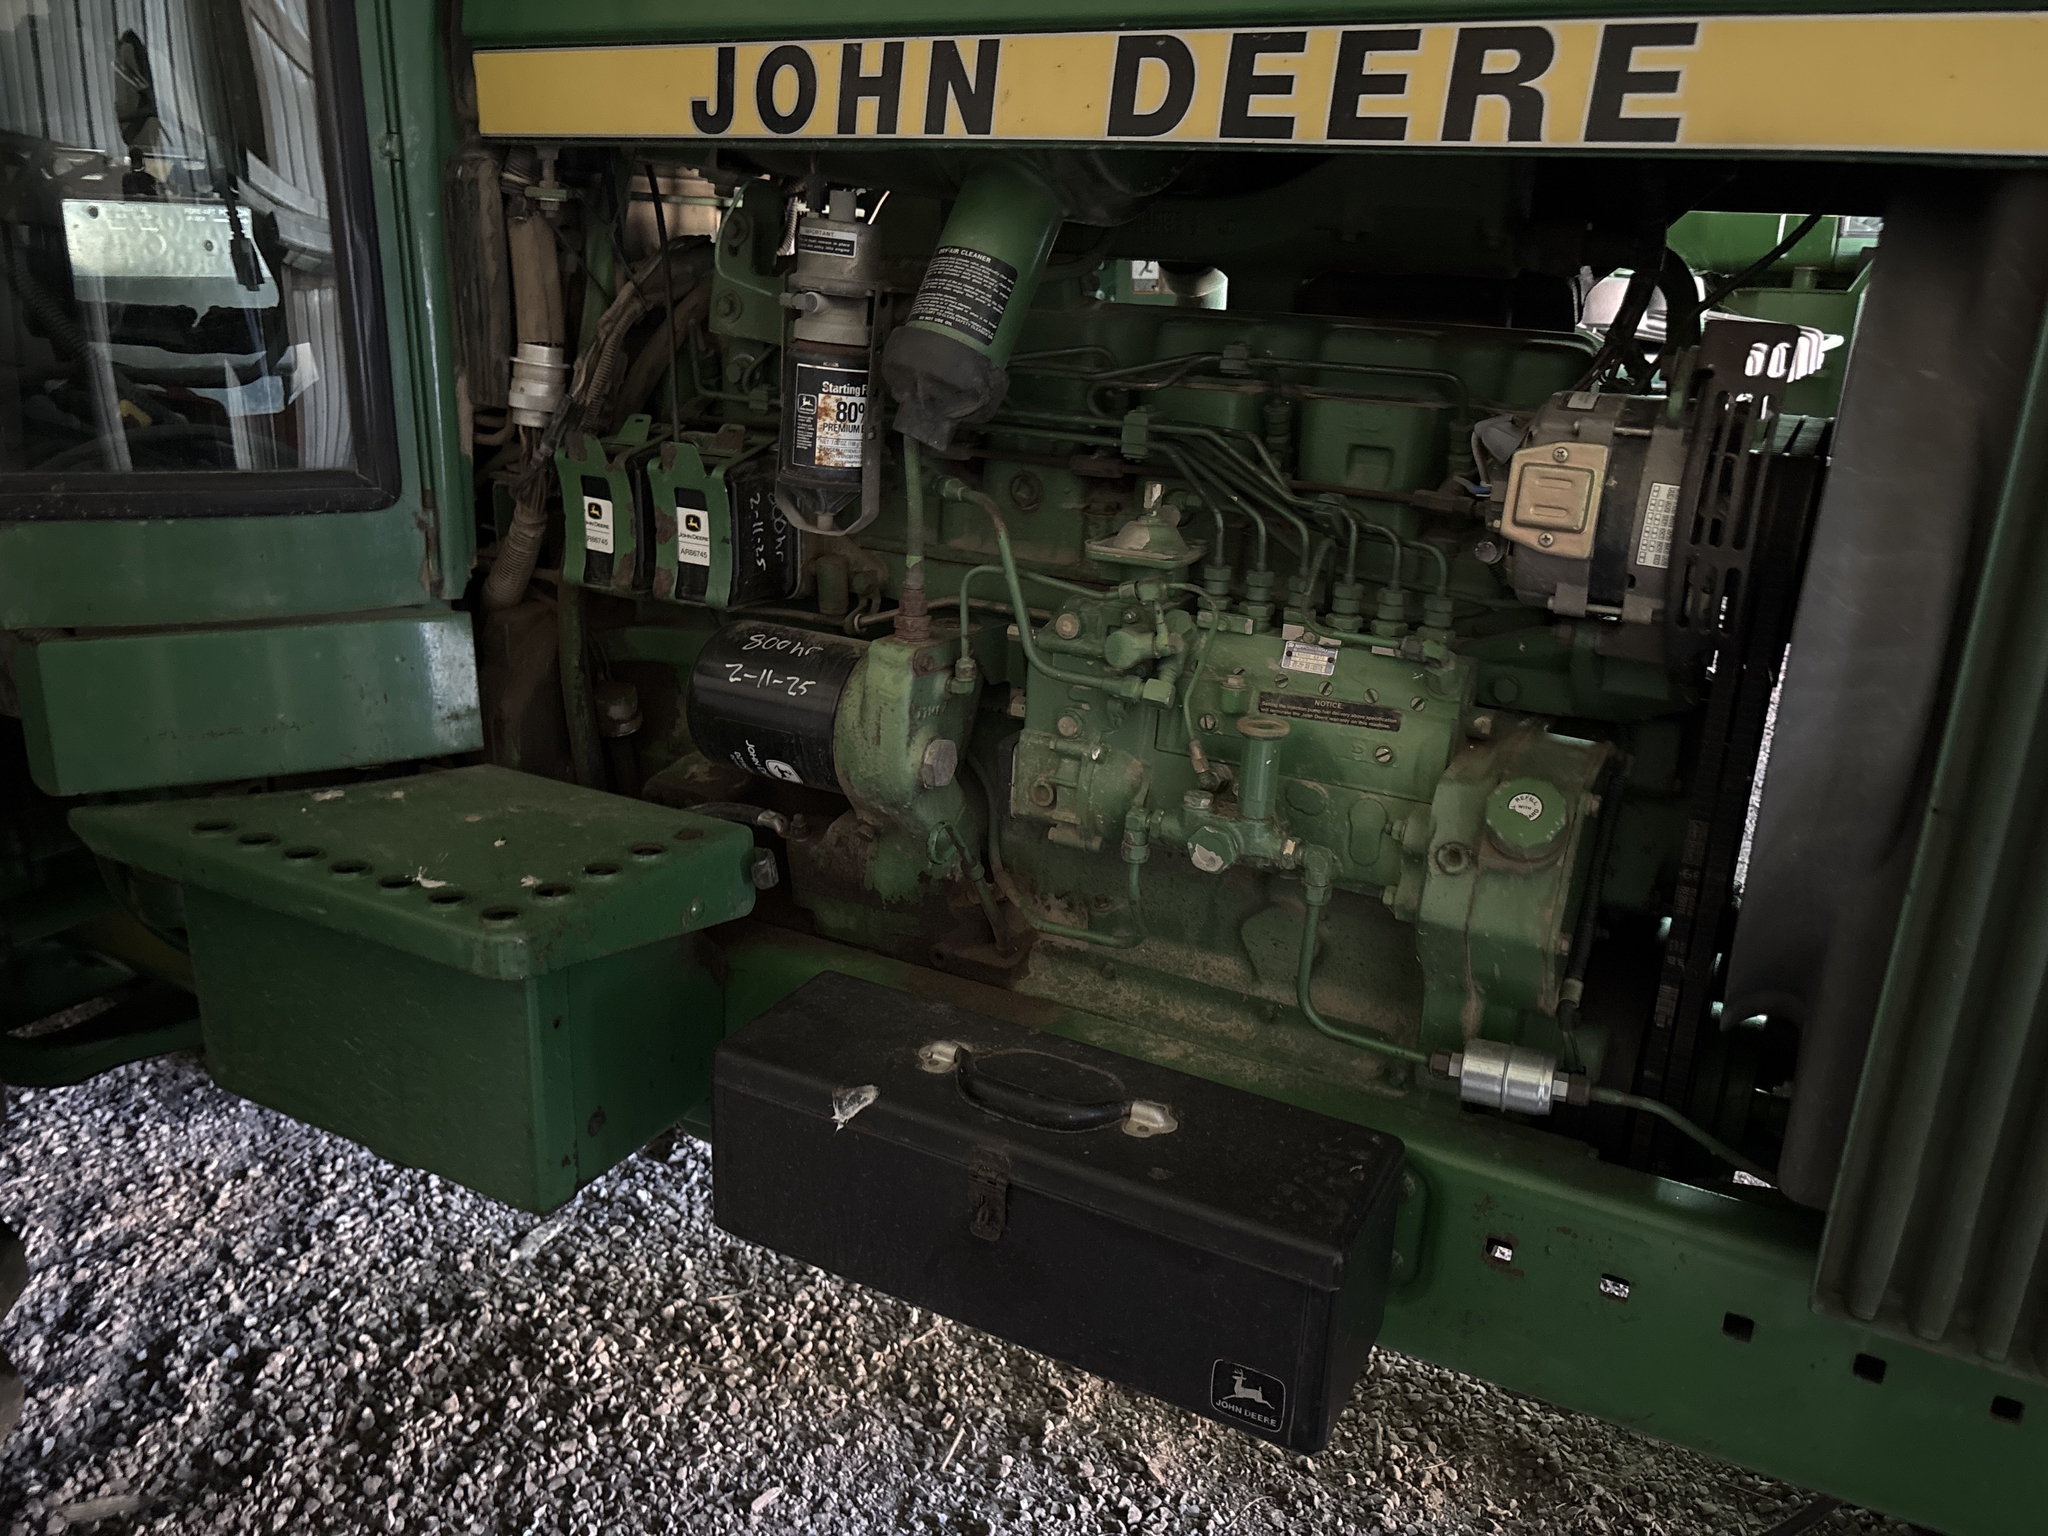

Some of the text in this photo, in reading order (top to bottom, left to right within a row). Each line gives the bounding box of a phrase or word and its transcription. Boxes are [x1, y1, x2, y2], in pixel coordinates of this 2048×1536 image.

[691, 22, 1697, 142] JOHN DEERE
[960, 249, 992, 264] CLEANER
[822, 380, 862, 397] Starting
[822, 423, 860, 434] PREMIUM
[692, 534, 709, 542] DEERE
[749, 492, 767, 572] 2-11-25
[725, 663, 816, 696] 2-11-25
[745, 739, 762, 768] JOHN
[1514, 795, 1539, 806] REFILL
[1215, 1399, 1277, 1428] JOHN DEERE
